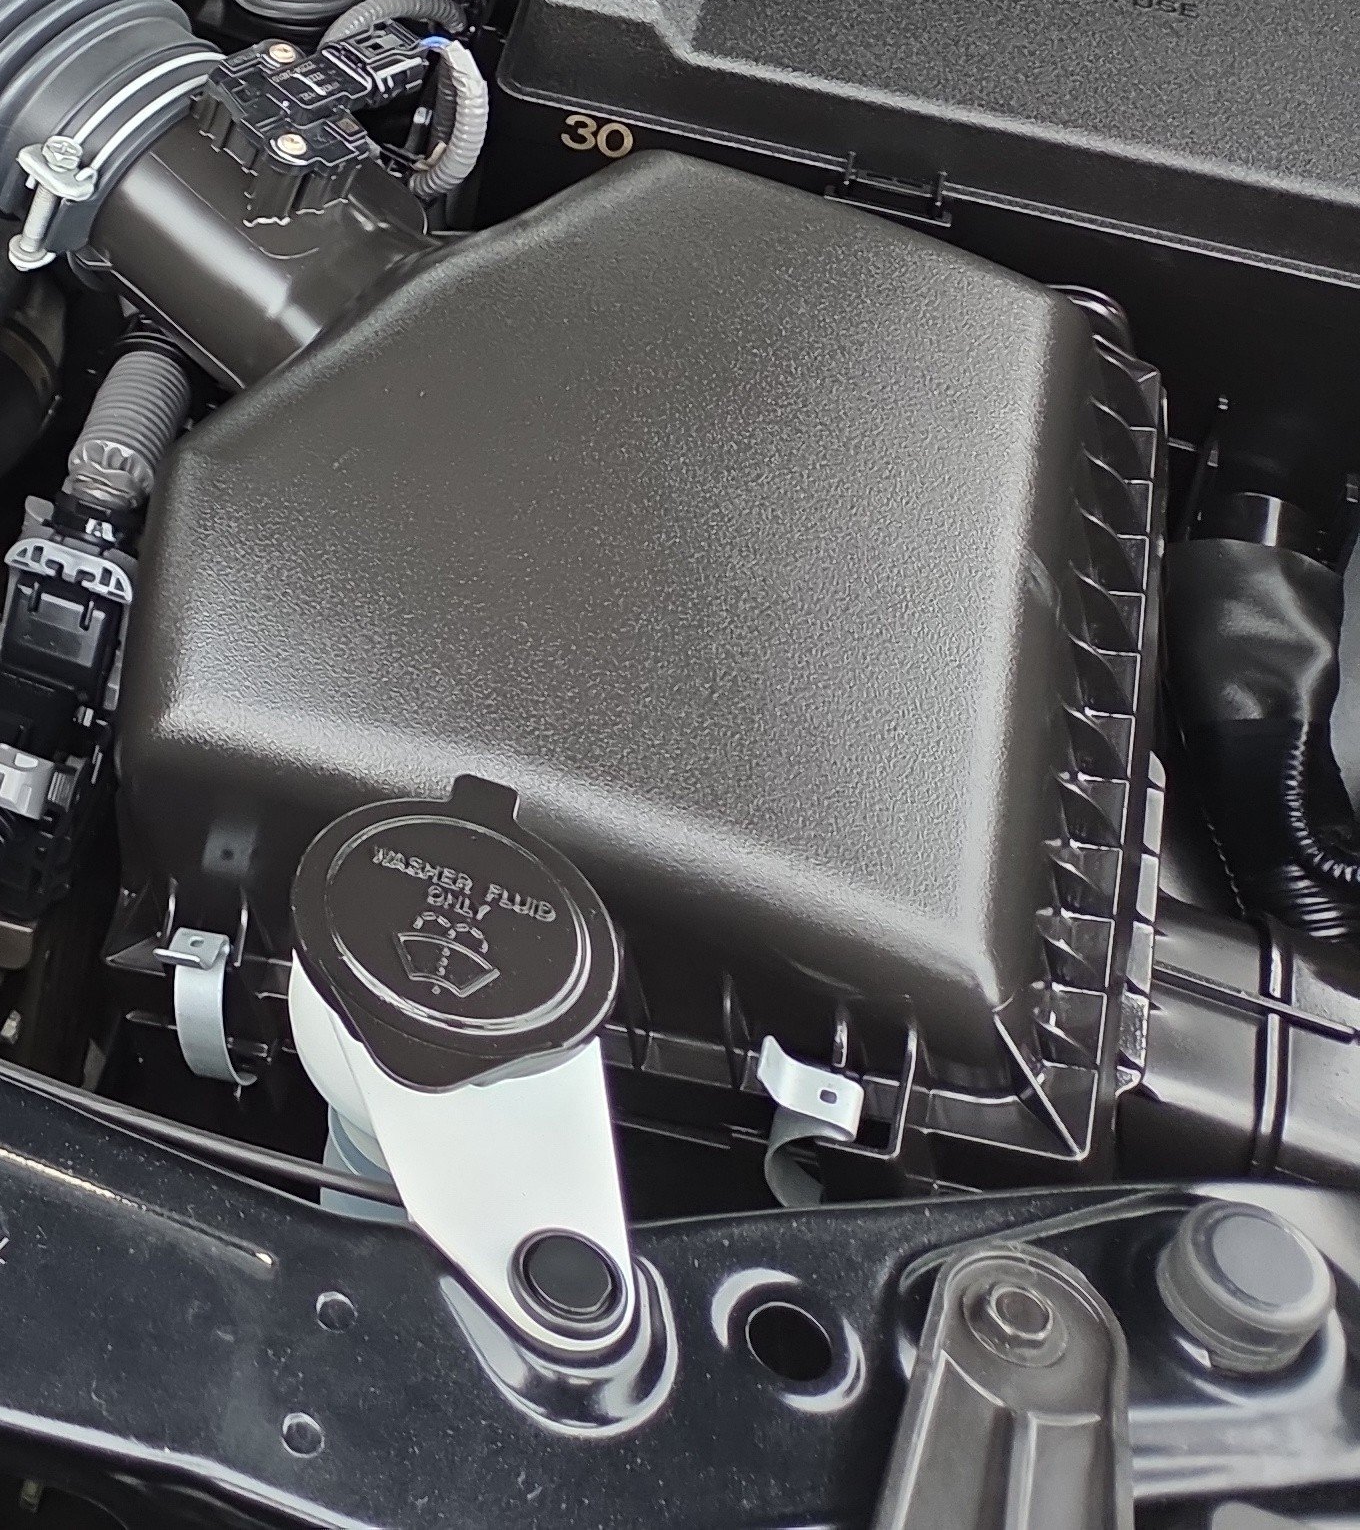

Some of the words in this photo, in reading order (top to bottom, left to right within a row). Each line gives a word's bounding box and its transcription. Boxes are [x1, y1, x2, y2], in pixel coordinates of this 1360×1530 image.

[560, 114, 634, 158] 30
[371, 845, 475, 895] WASHER
[484, 883, 557, 923] FLUID
[426, 884, 492, 922] ONLY
